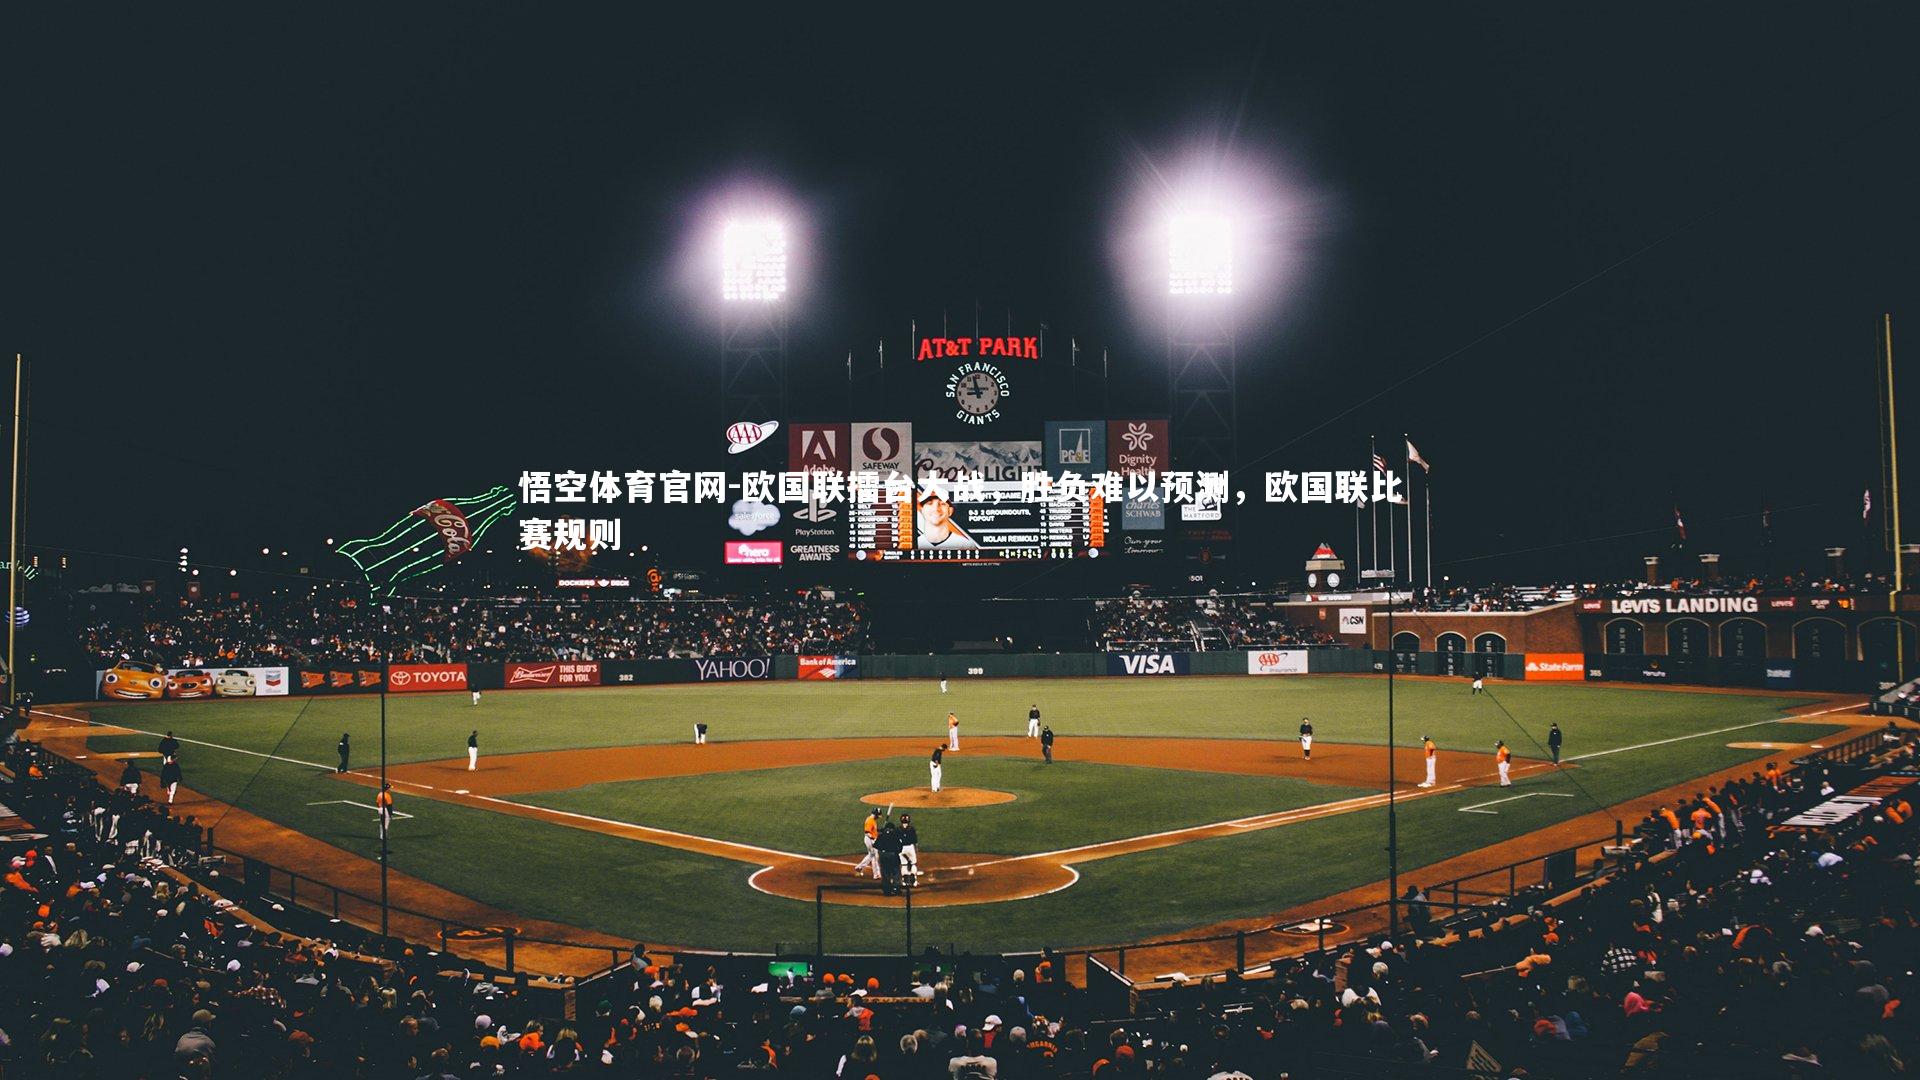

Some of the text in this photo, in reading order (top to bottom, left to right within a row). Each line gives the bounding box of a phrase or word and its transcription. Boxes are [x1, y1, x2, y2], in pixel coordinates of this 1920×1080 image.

[917, 337, 1038, 361] AT&T PARK
[946, 362, 1010, 398] SAN FRANCISCO
[956, 409, 1001, 425] GIANTS
[728, 423, 762, 444] AAA
[1061, 450, 1089, 463] PG&E
[1119, 454, 1157, 466] Dignity
[862, 462, 900, 470] SAFEWAY
[1125, 510, 1161, 518] SCHWAB
[434, 514, 471, 555] Cola
[790, 545, 840, 553] GREATNESS
[558, 579, 630, 587] DOCKERS DECK
[1666, 597, 1758, 613] LANDING
[1350, 616, 1364, 624] CSN
[800, 658, 856, 666] Bank of America
[1119, 654, 1176, 674] VISA
[559, 664, 598, 673] THIS BUD'S
[695, 658, 770, 681] YAHOO!
[413, 671, 466, 683] TOYOTA
[559, 673, 590, 682] FOR YOU.
